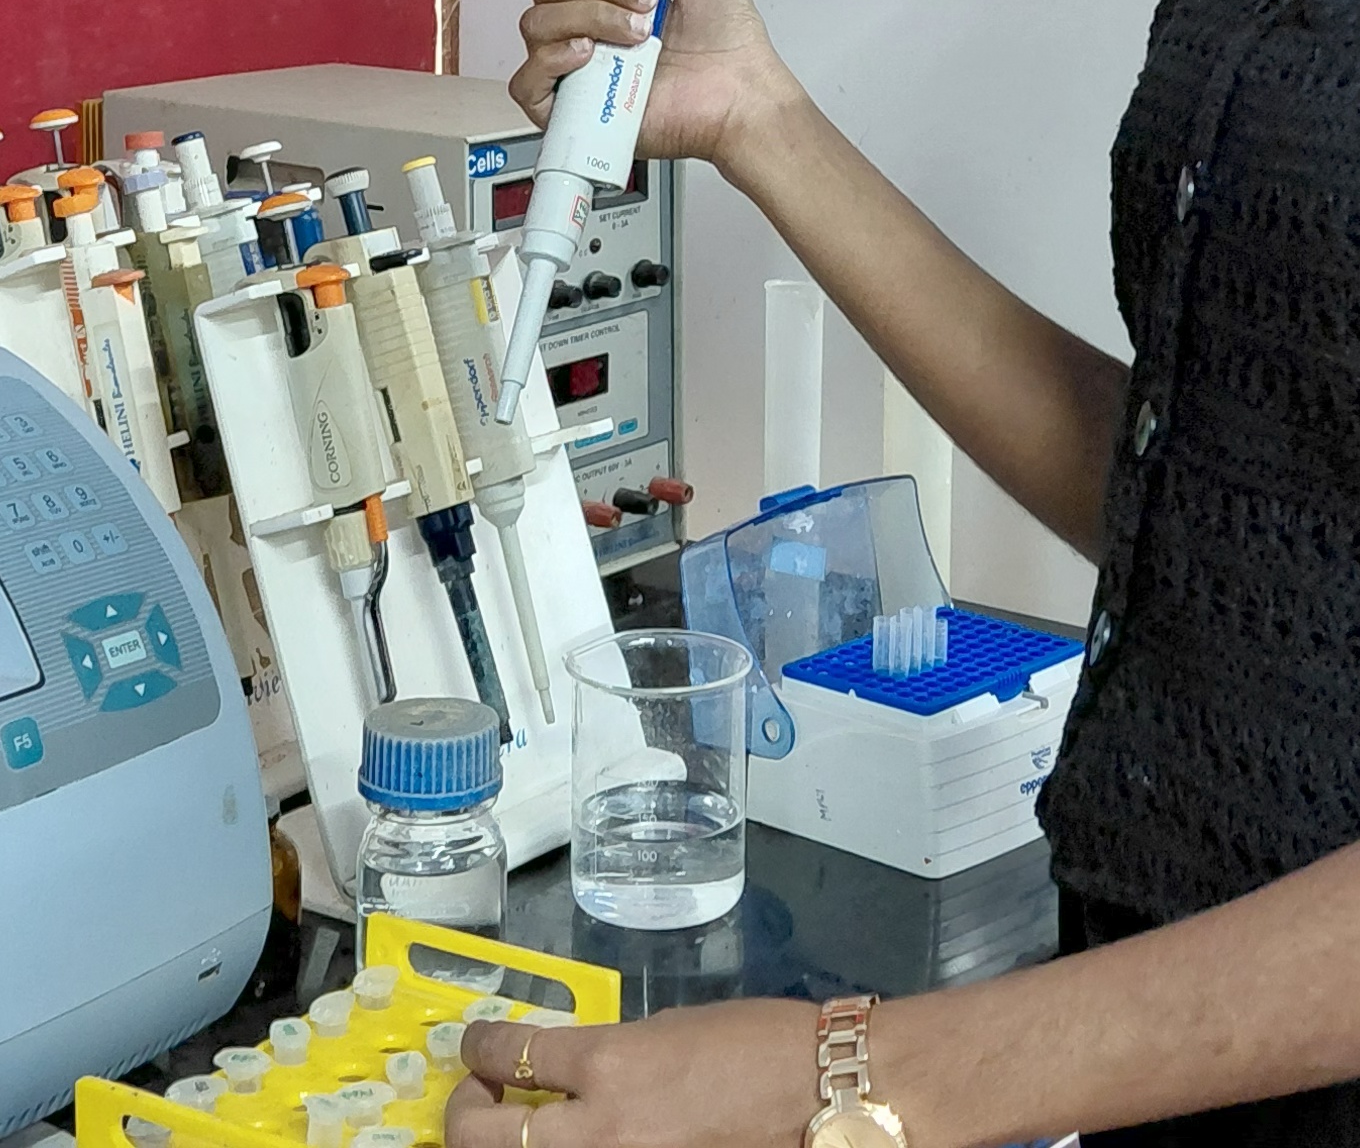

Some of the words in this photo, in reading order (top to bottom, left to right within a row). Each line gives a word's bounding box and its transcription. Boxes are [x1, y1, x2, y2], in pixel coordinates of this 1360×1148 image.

[600, 55, 625, 124] eppendorf
[623, 63, 644, 114] Research
[586, 155, 611, 172] 1000
[590, 324, 620, 339] CONTROL
[114, 401, 136, 456] HELINI
[317, 410, 341, 484] CORNING
[12, 457, 27, 471] 5
[42, 494, 56, 509] 8
[75, 486, 88, 501] 9
[6, 502, 19, 517] 7
[72, 539, 84, 554] 0
[108, 638, 141, 659] ENTER
[13, 732, 33, 751] F5
[637, 850, 658, 862] 100
